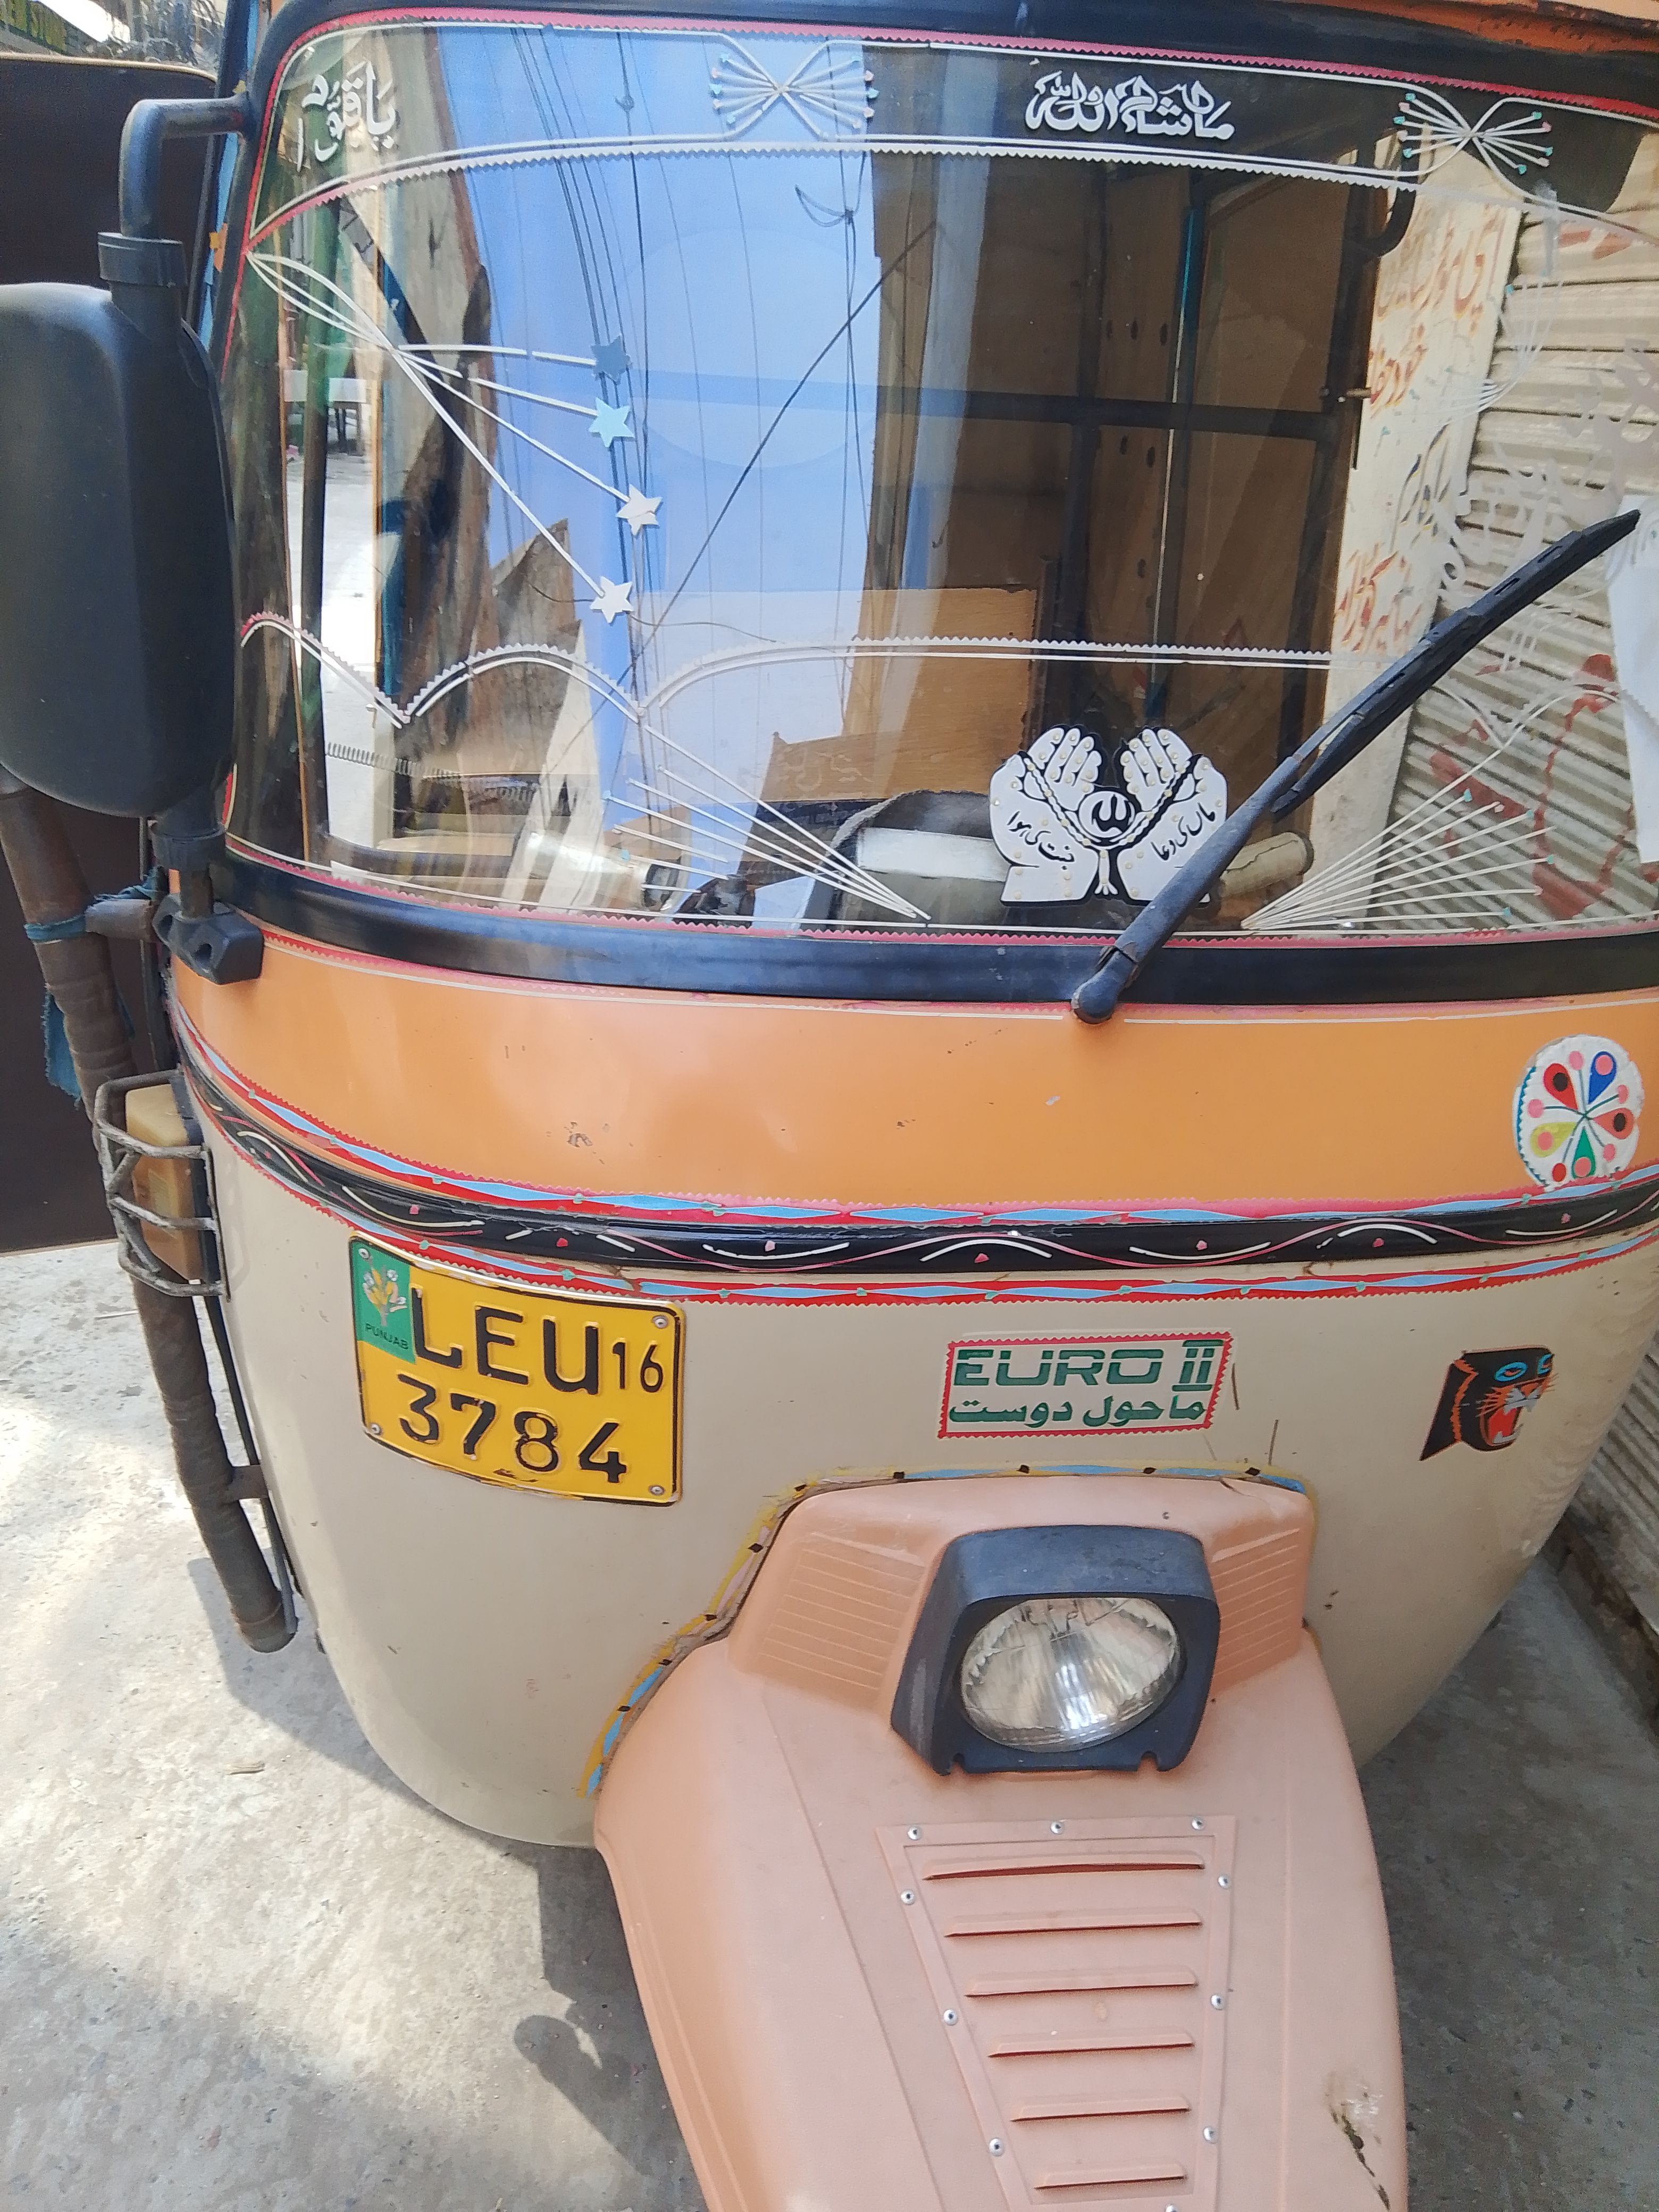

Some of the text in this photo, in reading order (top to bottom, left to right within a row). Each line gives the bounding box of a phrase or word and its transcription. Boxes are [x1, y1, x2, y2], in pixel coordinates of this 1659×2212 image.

[365, 1322, 409, 1350] PUNJAB
[411, 1286, 664, 1395] LEU 16
[952, 1348, 1164, 1387] EURO
[397, 1373, 627, 1484] 3784
[949, 1395, 1206, 1428] ماحول دوست
